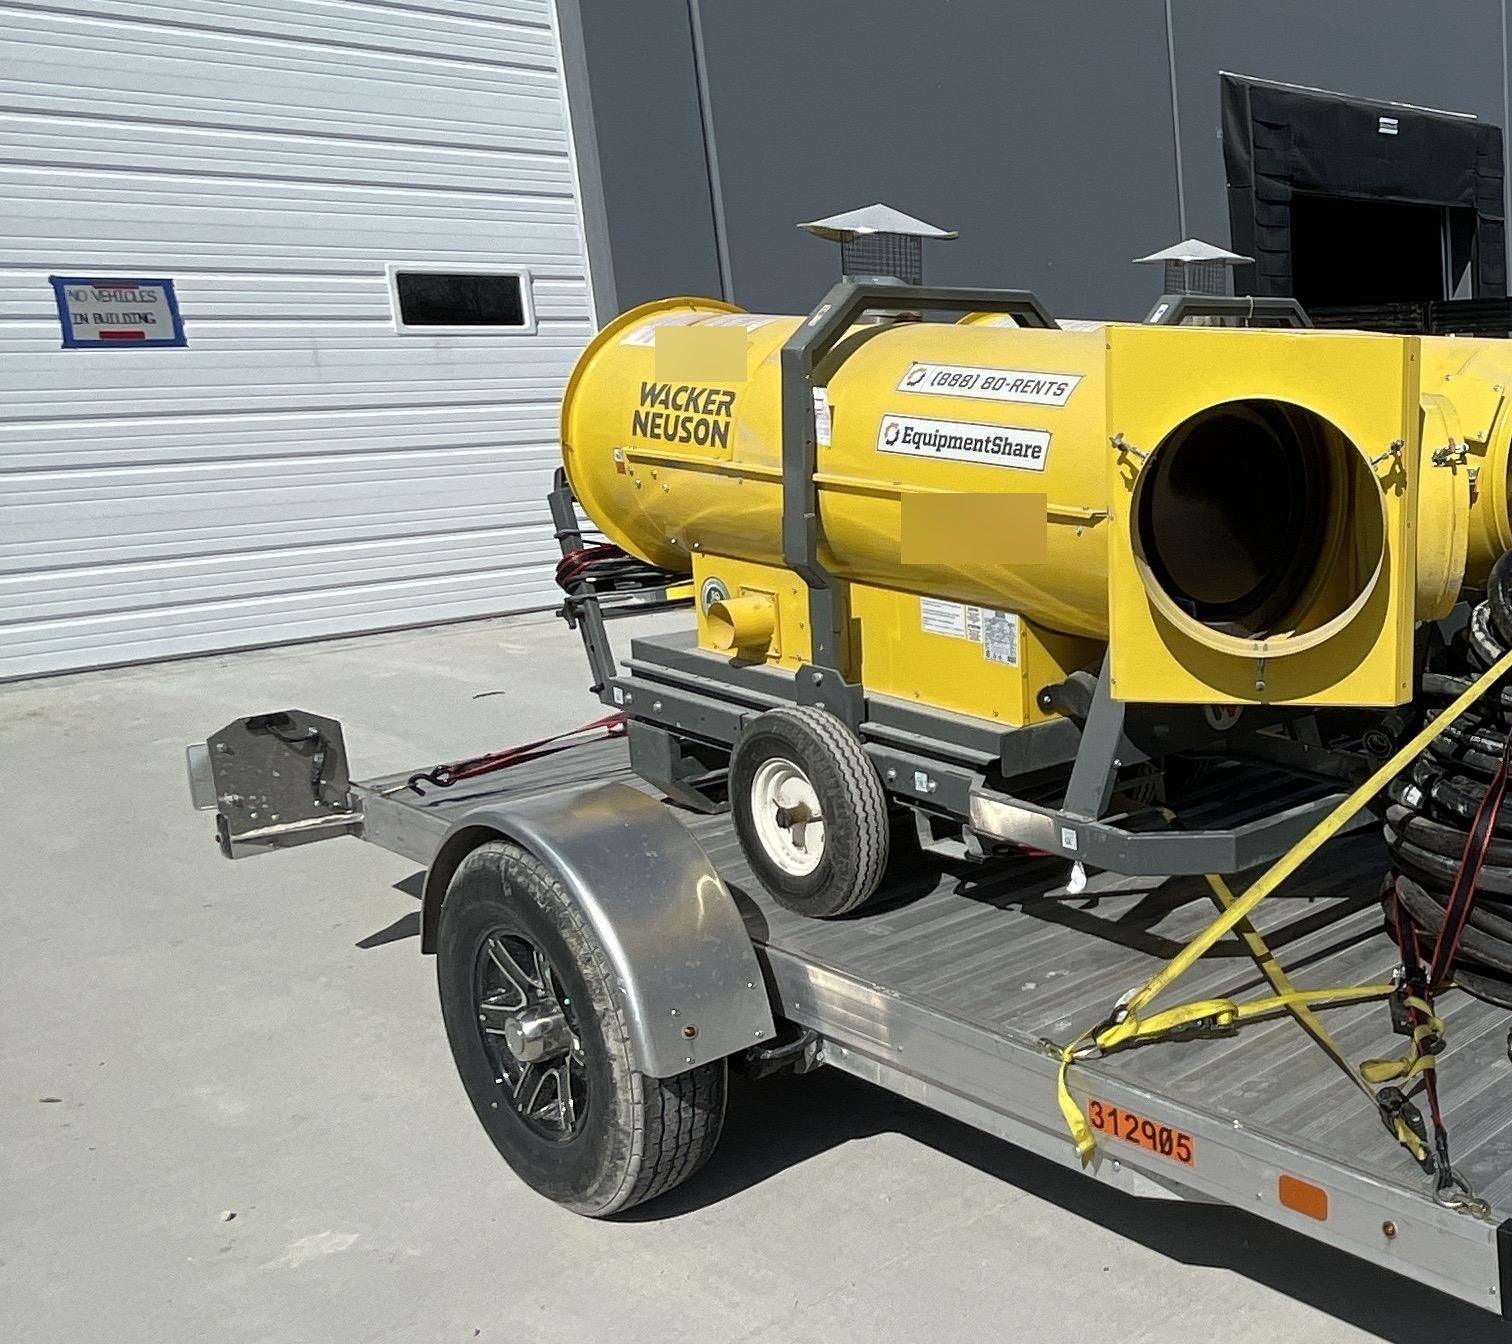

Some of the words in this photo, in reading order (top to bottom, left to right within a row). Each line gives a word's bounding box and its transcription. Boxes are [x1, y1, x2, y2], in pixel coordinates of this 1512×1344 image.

[67, 289, 88, 303] NO
[92, 289, 158, 304] VEHICLES
[72, 312, 89, 325] IN
[93, 312, 157, 325] BUILDING
[640, 381, 737, 418] WACKER
[930, 370, 980, 390] (888)
[981, 376, 1070, 397] 80-RENTS
[632, 410, 731, 449] NEUSON
[900, 425, 1043, 460] EquipmentShare
[1089, 1100, 1194, 1163] 312905
